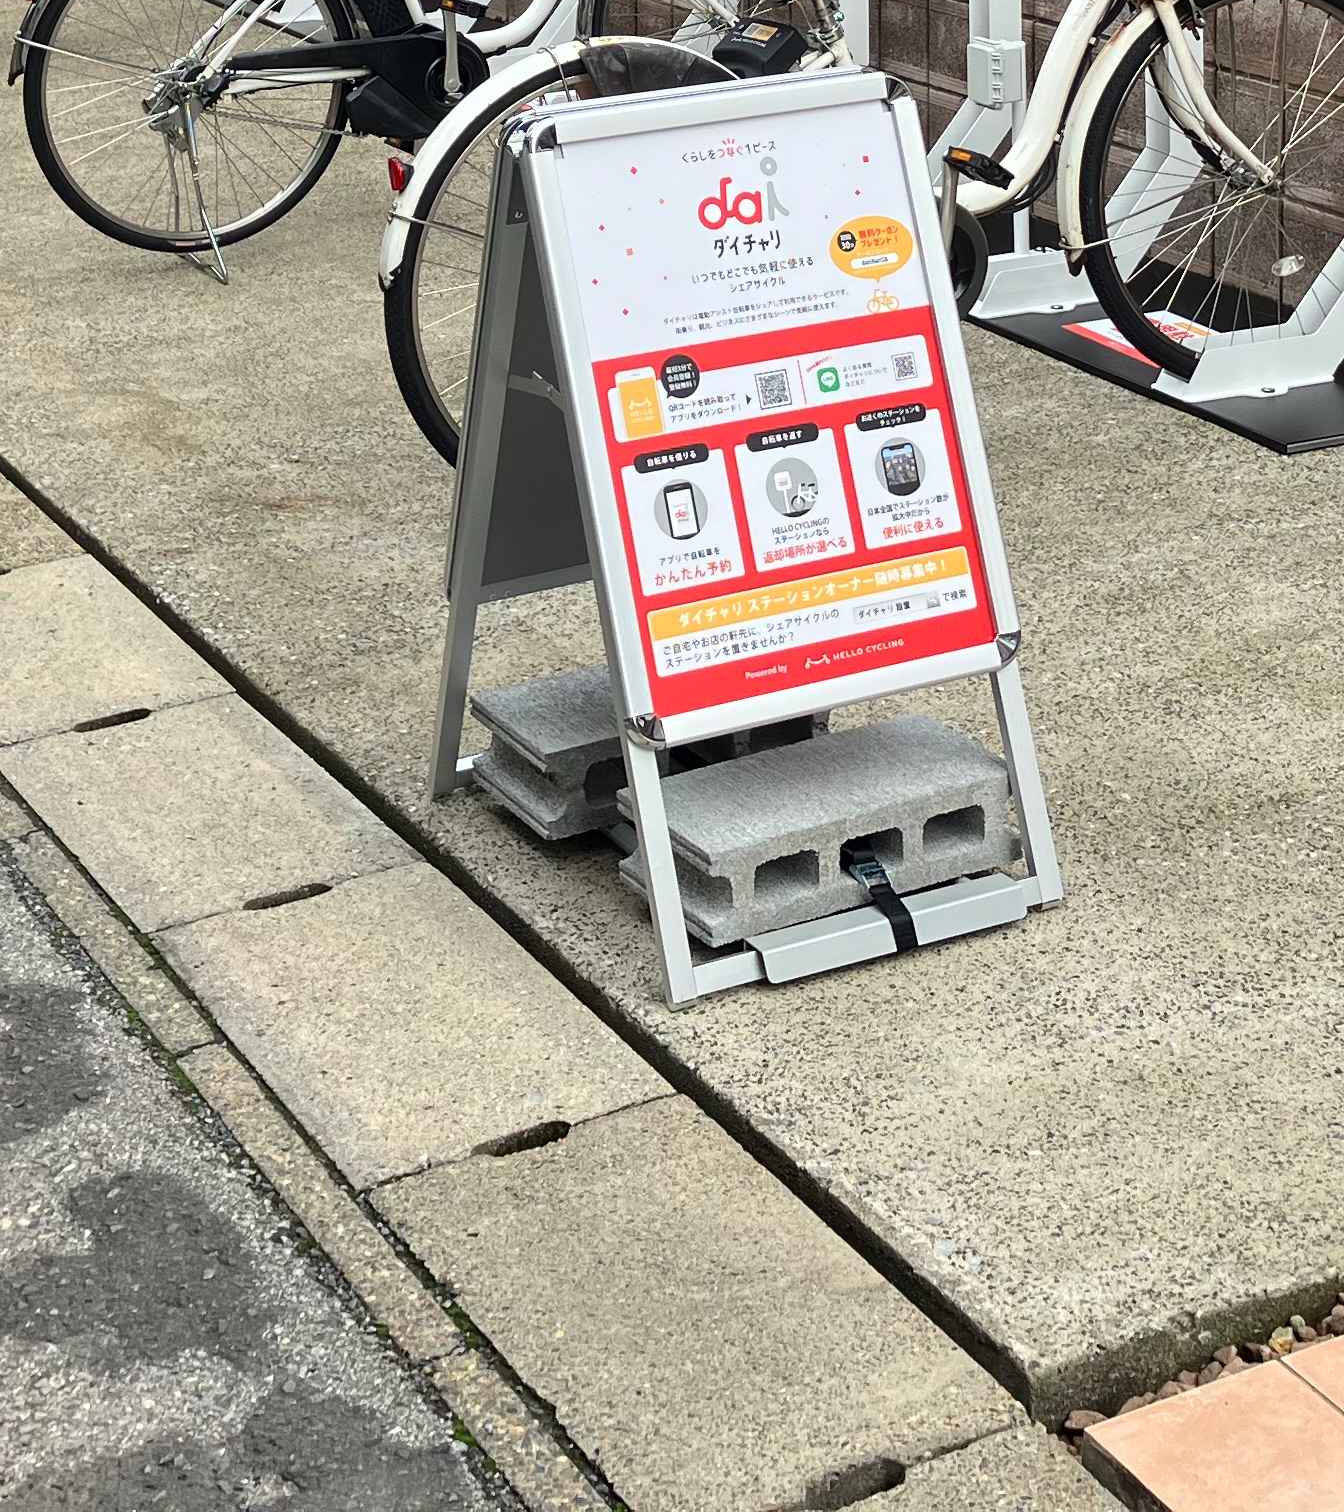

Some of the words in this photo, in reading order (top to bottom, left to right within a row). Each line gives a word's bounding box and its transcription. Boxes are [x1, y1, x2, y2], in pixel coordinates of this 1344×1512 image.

[713, 229, 782, 260] ダイチャリ
[690, 255, 814, 284] いつでもどこでも気軽に使える
[728, 275, 785, 293] シェアサイクル
[760, 429, 803, 445] 自転車を返す
[646, 449, 696, 467] 自転車を借りる
[773, 526, 829, 545] ステーションなら
[882, 515, 944, 540] 便利に使える
[659, 545, 720, 567] アプリで自転車を
[762, 534, 847, 565] 返却場所が選べる
[654, 558, 733, 588] かんたん予約
[678, 600, 744, 628] ダイチャリ
[857, 603, 894, 619] ダイチャリ
[662, 605, 839, 659] ご自宅やお店の軒先に、シェアサイクルの
[832, 647, 864, 661] HELLO
[865, 639, 905, 654] CYCLING
[744, 666, 777, 679] Powered
[778, 664, 788, 675] by
